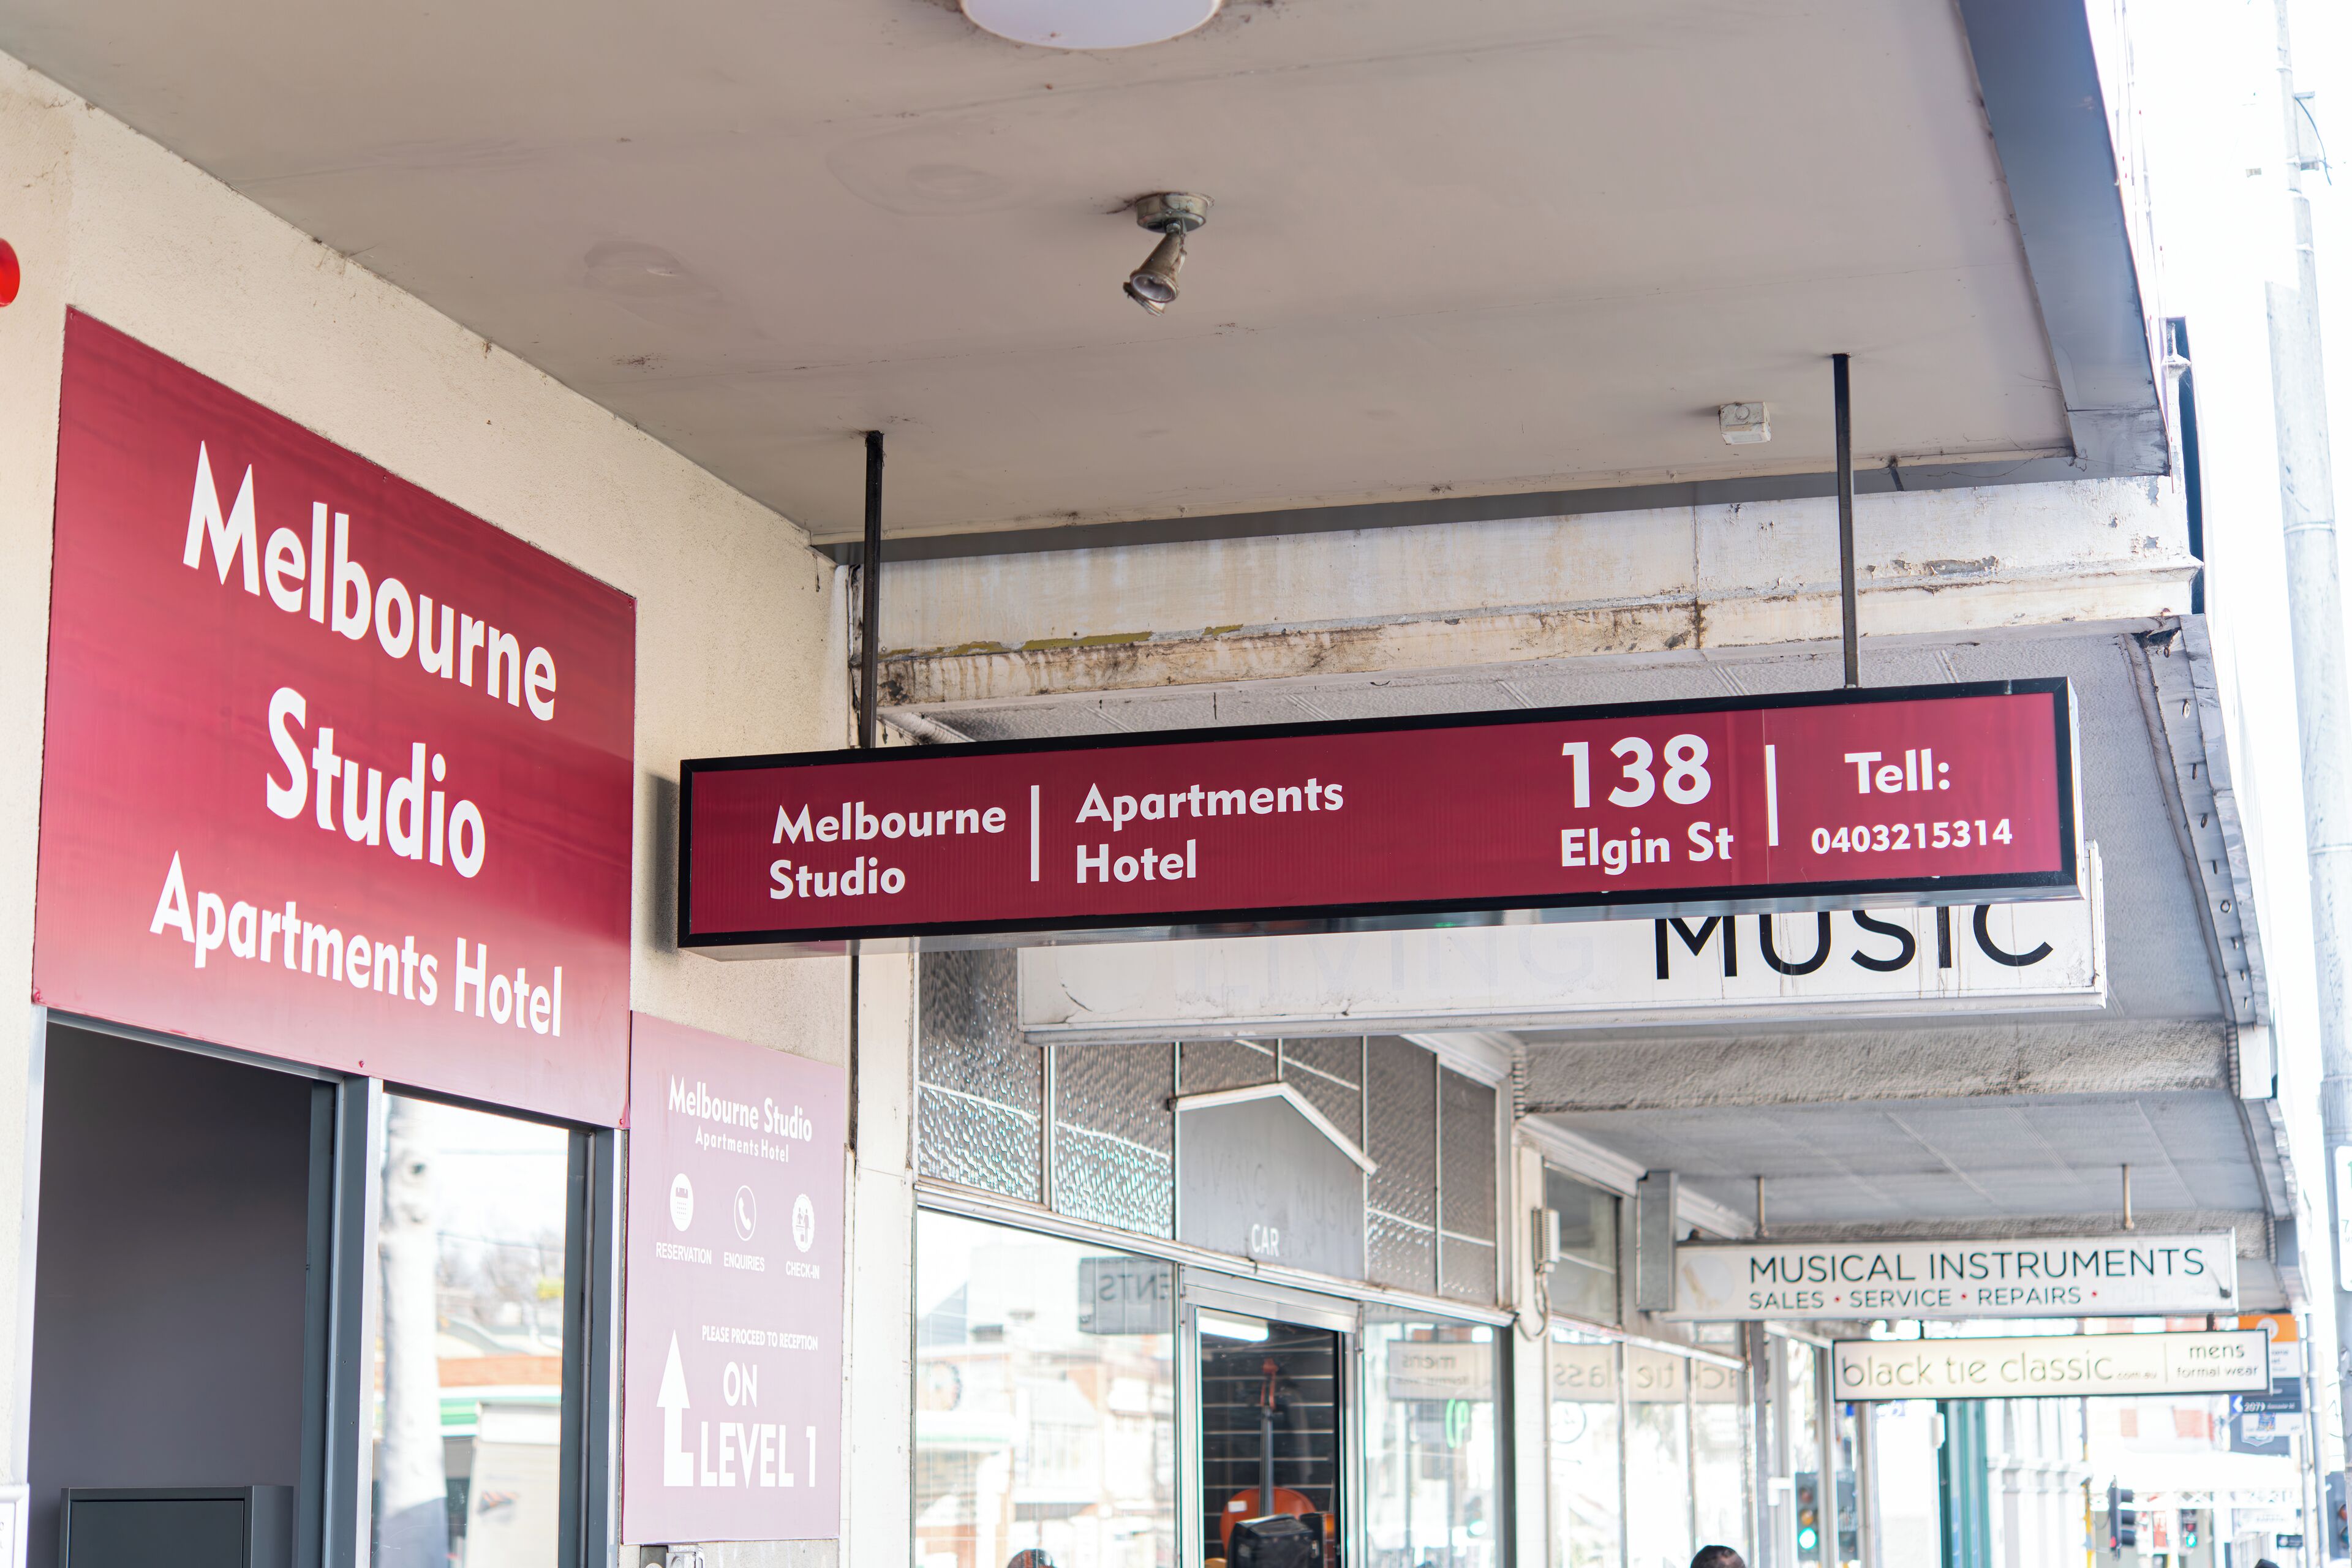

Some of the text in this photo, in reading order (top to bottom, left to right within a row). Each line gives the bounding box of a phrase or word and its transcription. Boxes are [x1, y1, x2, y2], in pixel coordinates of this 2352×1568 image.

[183, 440, 557, 721] Melbourne
[266, 687, 485, 878] Studio
[1562, 734, 1711, 808] 138
[1845, 748, 1950, 793] Tell:
[773, 802, 1006, 843] Melbourne
[1076, 778, 1344, 831] Apartments
[1562, 822, 1733, 875] Elgin St
[1812, 819, 2012, 854] 0403215314
[771, 856, 905, 899] Studio
[1077, 839, 1196, 883] Hotel
[149, 851, 562, 1037] Apartments Hotel
[1656, 905, 2053, 979] MUSIC
[669, 1074, 812, 1141] Melbourne Studio
[695, 1126, 788, 1163] Apartments Hotel
[656, 1242, 712, 1265] RESERVATION
[1251, 1224, 1280, 1257] CAR
[723, 1252, 765, 1272] ENQUIRIES
[786, 1261, 820, 1280] CHECK-IN
[1749, 1248, 2205, 1284] MUSICAL INSTRUMENTS
[1749, 1286, 2081, 1310] SALES SERVICE REPAIRS
[702, 1325, 818, 1351] PLEASE PROCEED TO RECEPTION
[2190, 1344, 2245, 1359] mens
[723, 1362, 757, 1407] ON
[1842, 1355, 1933, 1387] black
[1946, 1355, 1987, 1384] tie
[2001, 1351, 2113, 1382] classic
[2178, 1366, 2220, 1378] formal
[2225, 1366, 2258, 1377] wear
[701, 1421, 816, 1489] LEVEL 1
